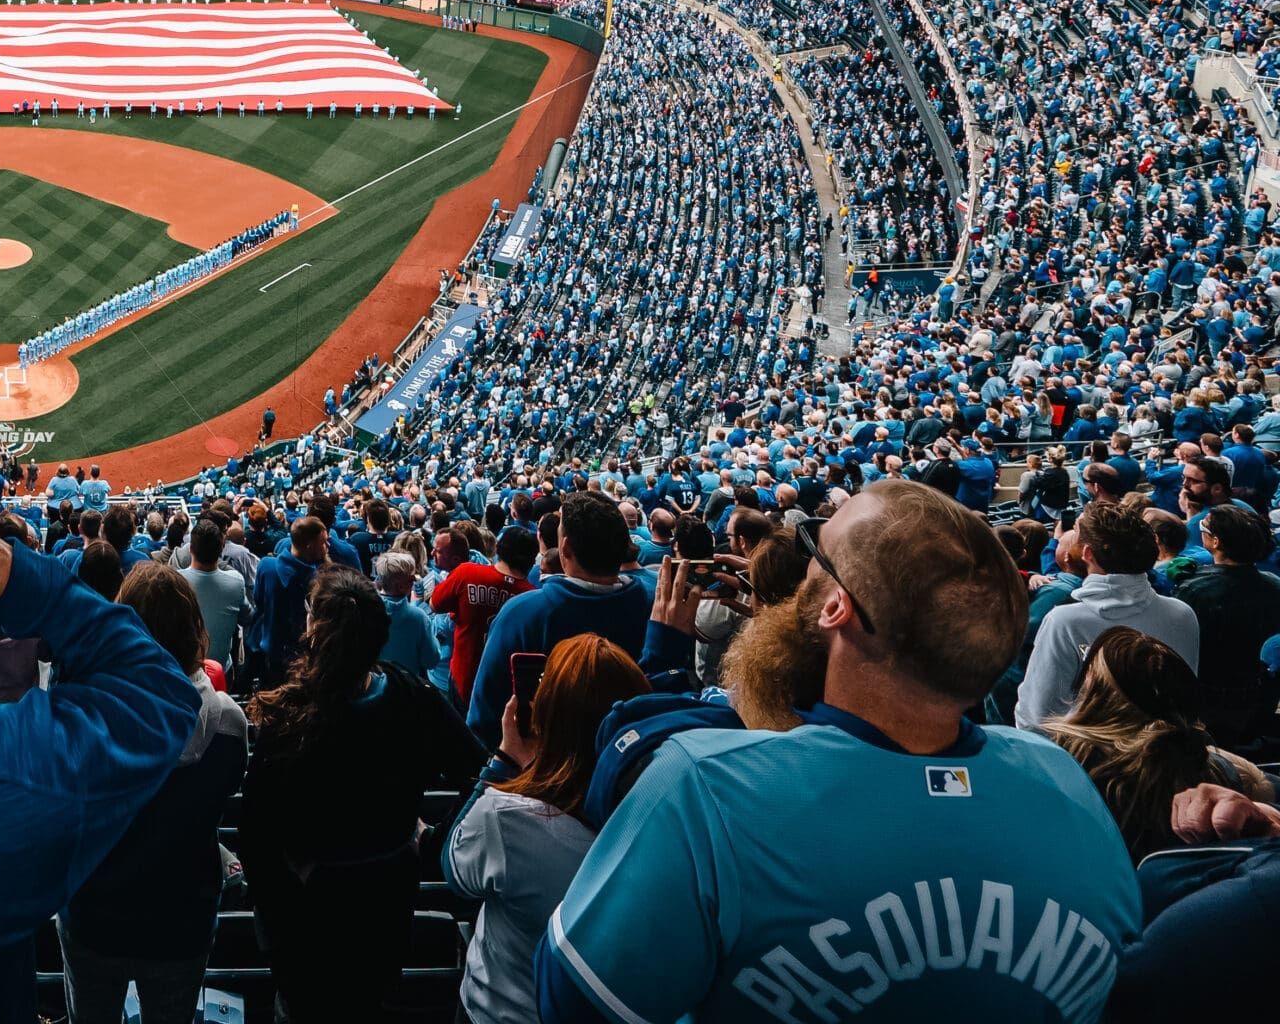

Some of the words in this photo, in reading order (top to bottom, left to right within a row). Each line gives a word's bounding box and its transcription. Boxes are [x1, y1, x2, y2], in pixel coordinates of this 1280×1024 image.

[401, 377, 424, 399] HOME
[419, 367, 433, 379] OF
[429, 355, 445, 371] THE
[24, 431, 55, 443] DAY
[682, 491, 694, 505] 13
